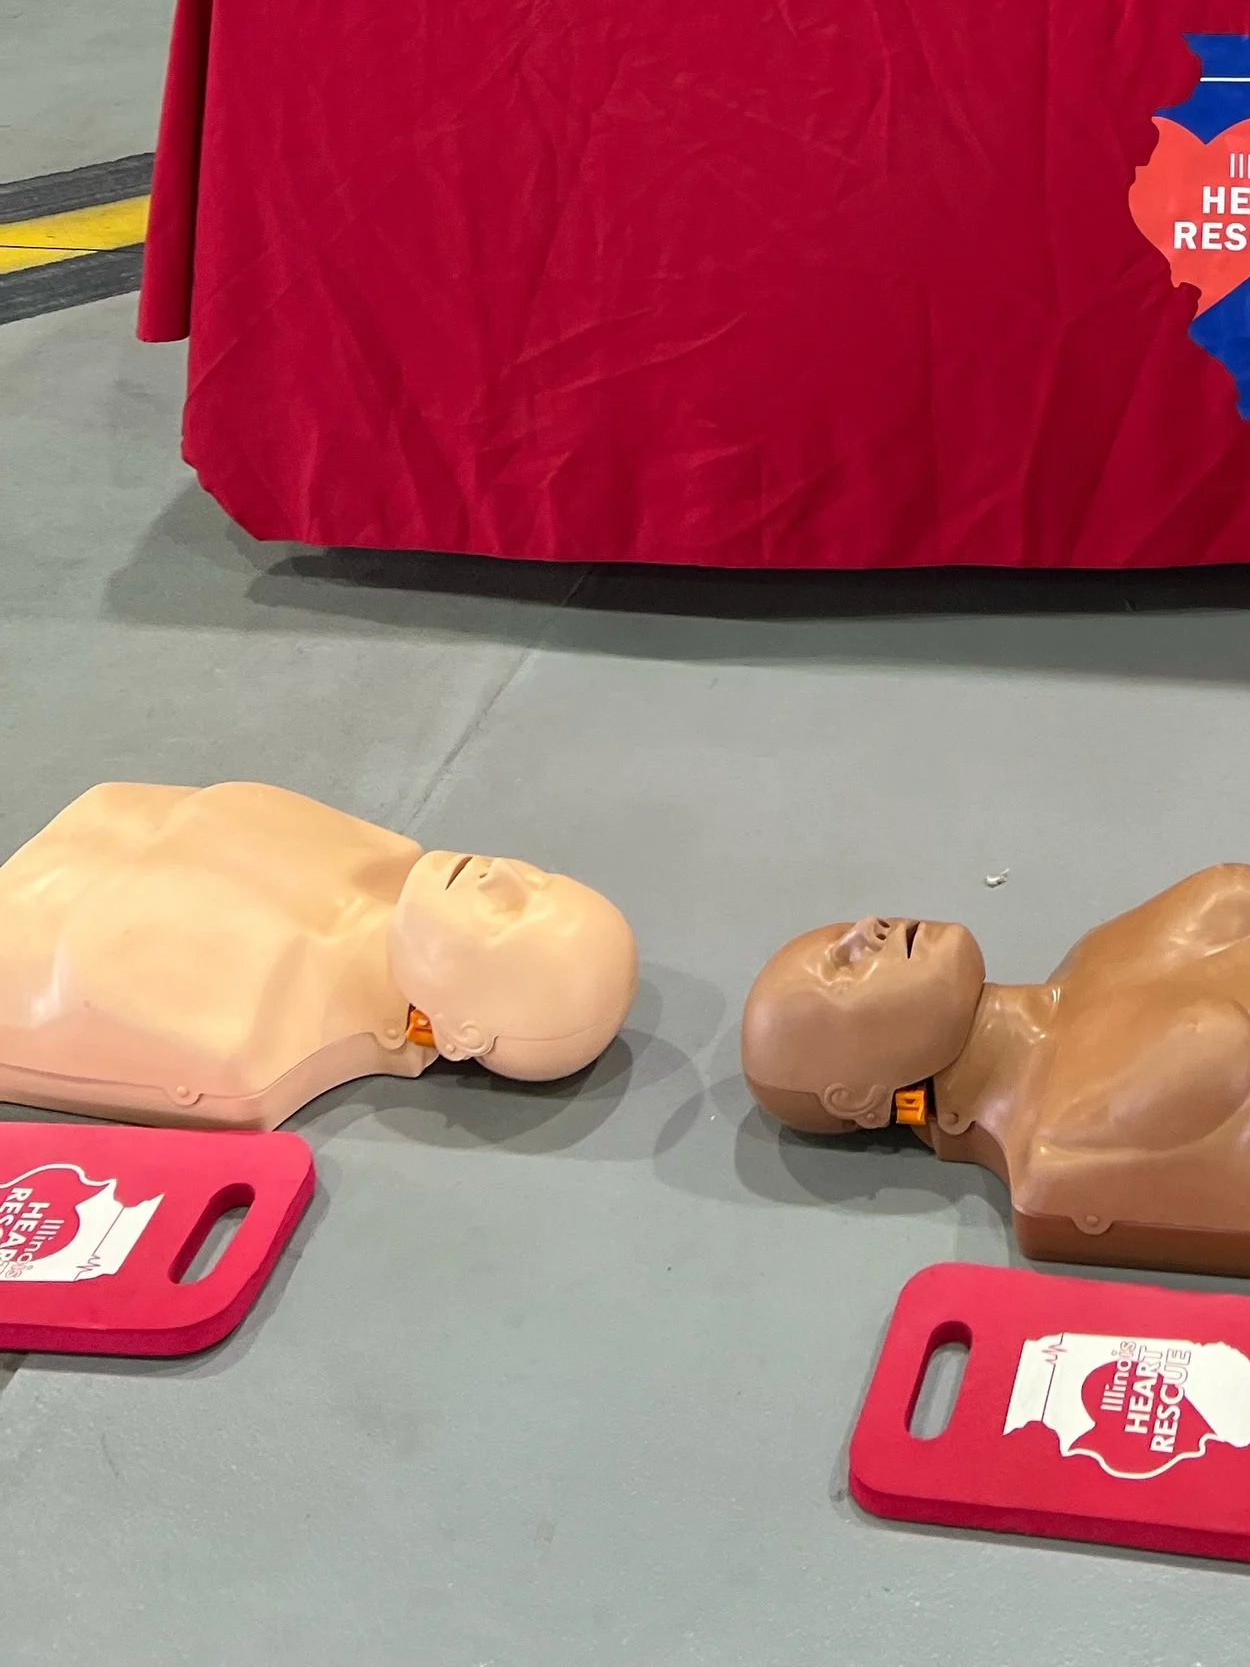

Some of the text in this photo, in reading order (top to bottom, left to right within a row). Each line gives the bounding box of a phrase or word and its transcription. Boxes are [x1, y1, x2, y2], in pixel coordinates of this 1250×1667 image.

[0, 1202, 51, 1274] HEAR
[1100, 1340, 1136, 1412] Illinois
[1124, 1345, 1163, 1434] HEART
[1150, 1348, 1191, 1453] RESCUE
